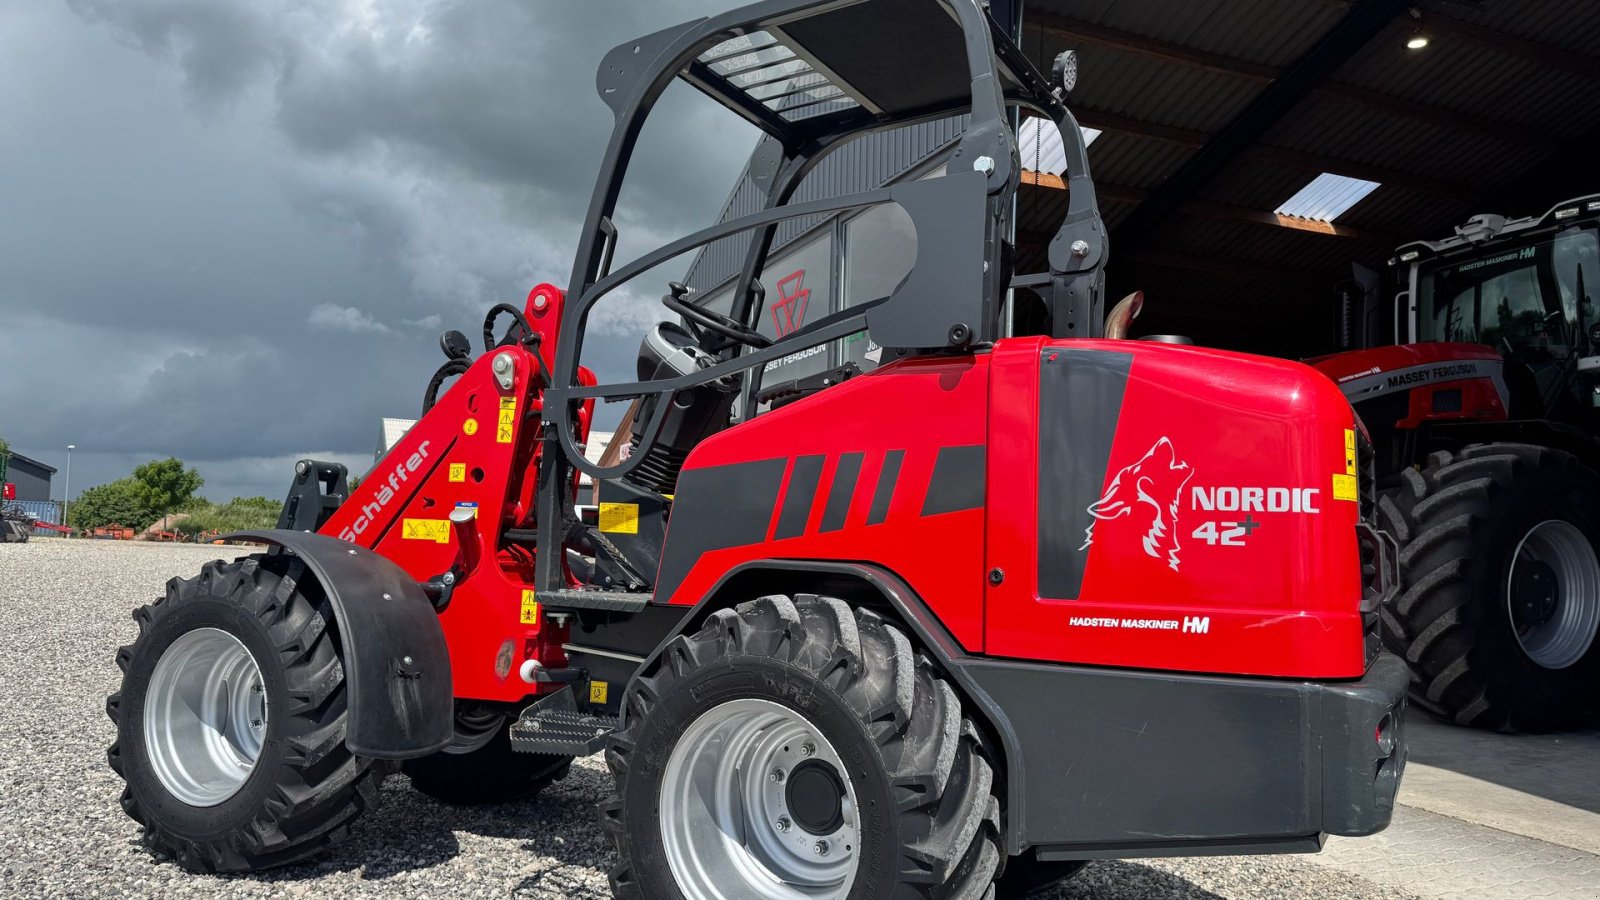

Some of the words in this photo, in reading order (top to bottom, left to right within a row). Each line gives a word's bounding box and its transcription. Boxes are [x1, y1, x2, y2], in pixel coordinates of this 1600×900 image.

[1486, 253, 1519, 266] MASKINER
[1387, 369, 1431, 389] MASSEY
[1432, 363, 1478, 379] FERGUSON
[338, 440, 431, 543] Schäffer
[1191, 486, 1320, 514] NORDIC
[1069, 616, 1120, 628] HADSTEN
[1120, 618, 1179, 630] MASKINER
[1182, 615, 1210, 634] HM
